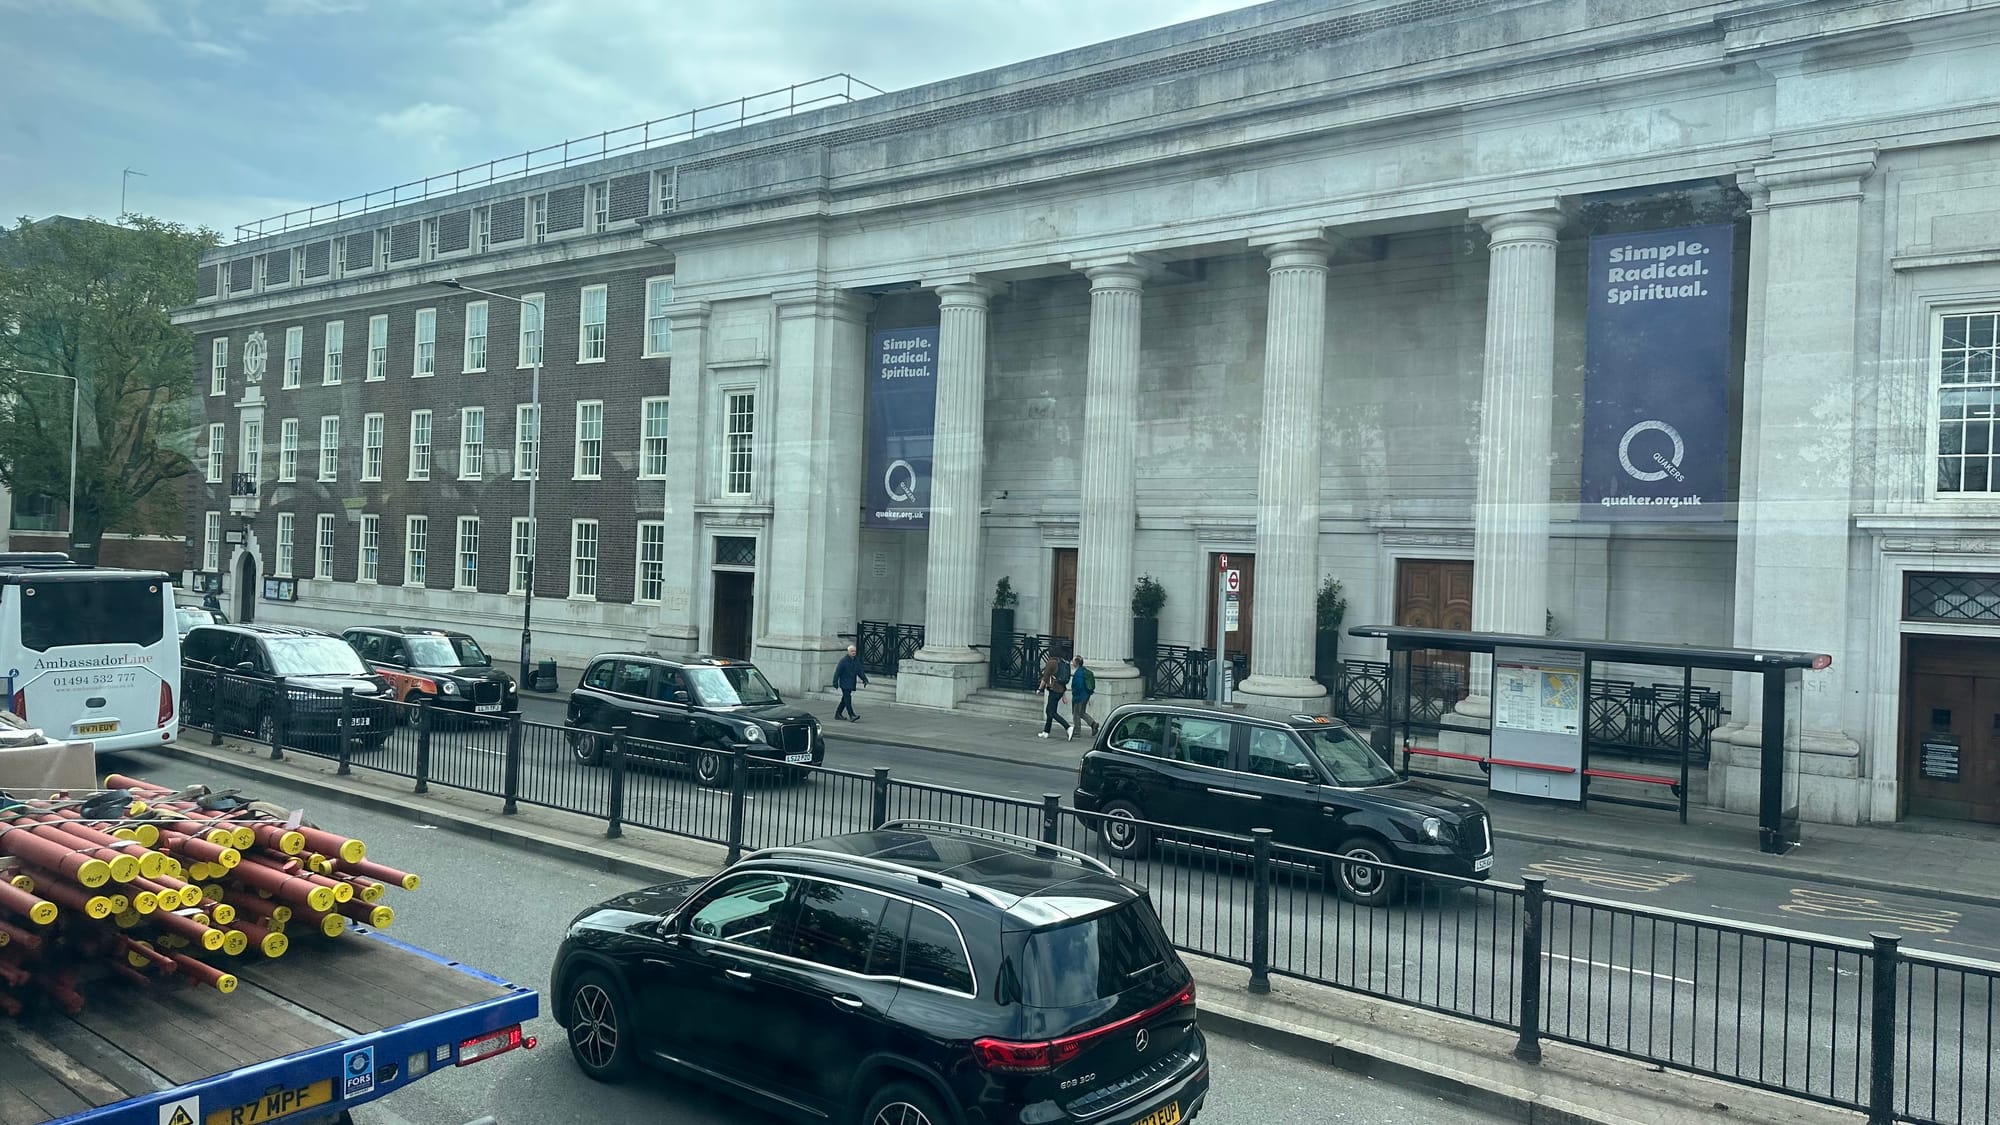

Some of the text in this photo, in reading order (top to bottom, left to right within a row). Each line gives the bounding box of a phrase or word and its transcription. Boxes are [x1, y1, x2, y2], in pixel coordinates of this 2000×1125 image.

[1609, 241, 1709, 263] Simple.
[1608, 260, 1709, 283] Radical.
[1607, 281, 1708, 305] Spiritual.
[883, 337, 931, 350] Simple.
[882, 351, 931, 364] Radical.
[881, 366, 930, 380] Spiritual.
[1653, 452, 1684, 482] QUAKERS
[1601, 495, 1701, 508] quaker.org.uk
[876, 510, 924, 520] quaker.org.uk
[34, 653, 153, 669] AmbassadorLine
[53, 673, 136, 686] 01494 532 777
[99, 723, 113, 732] EUY
[1778, 888, 1962, 934] BUS
[347, 1073, 371, 1088] FORS
[1079, 1072, 1096, 1084] 300
[231, 1086, 310, 1125] R7 MPF
[1158, 1102, 1177, 1125] EUP
